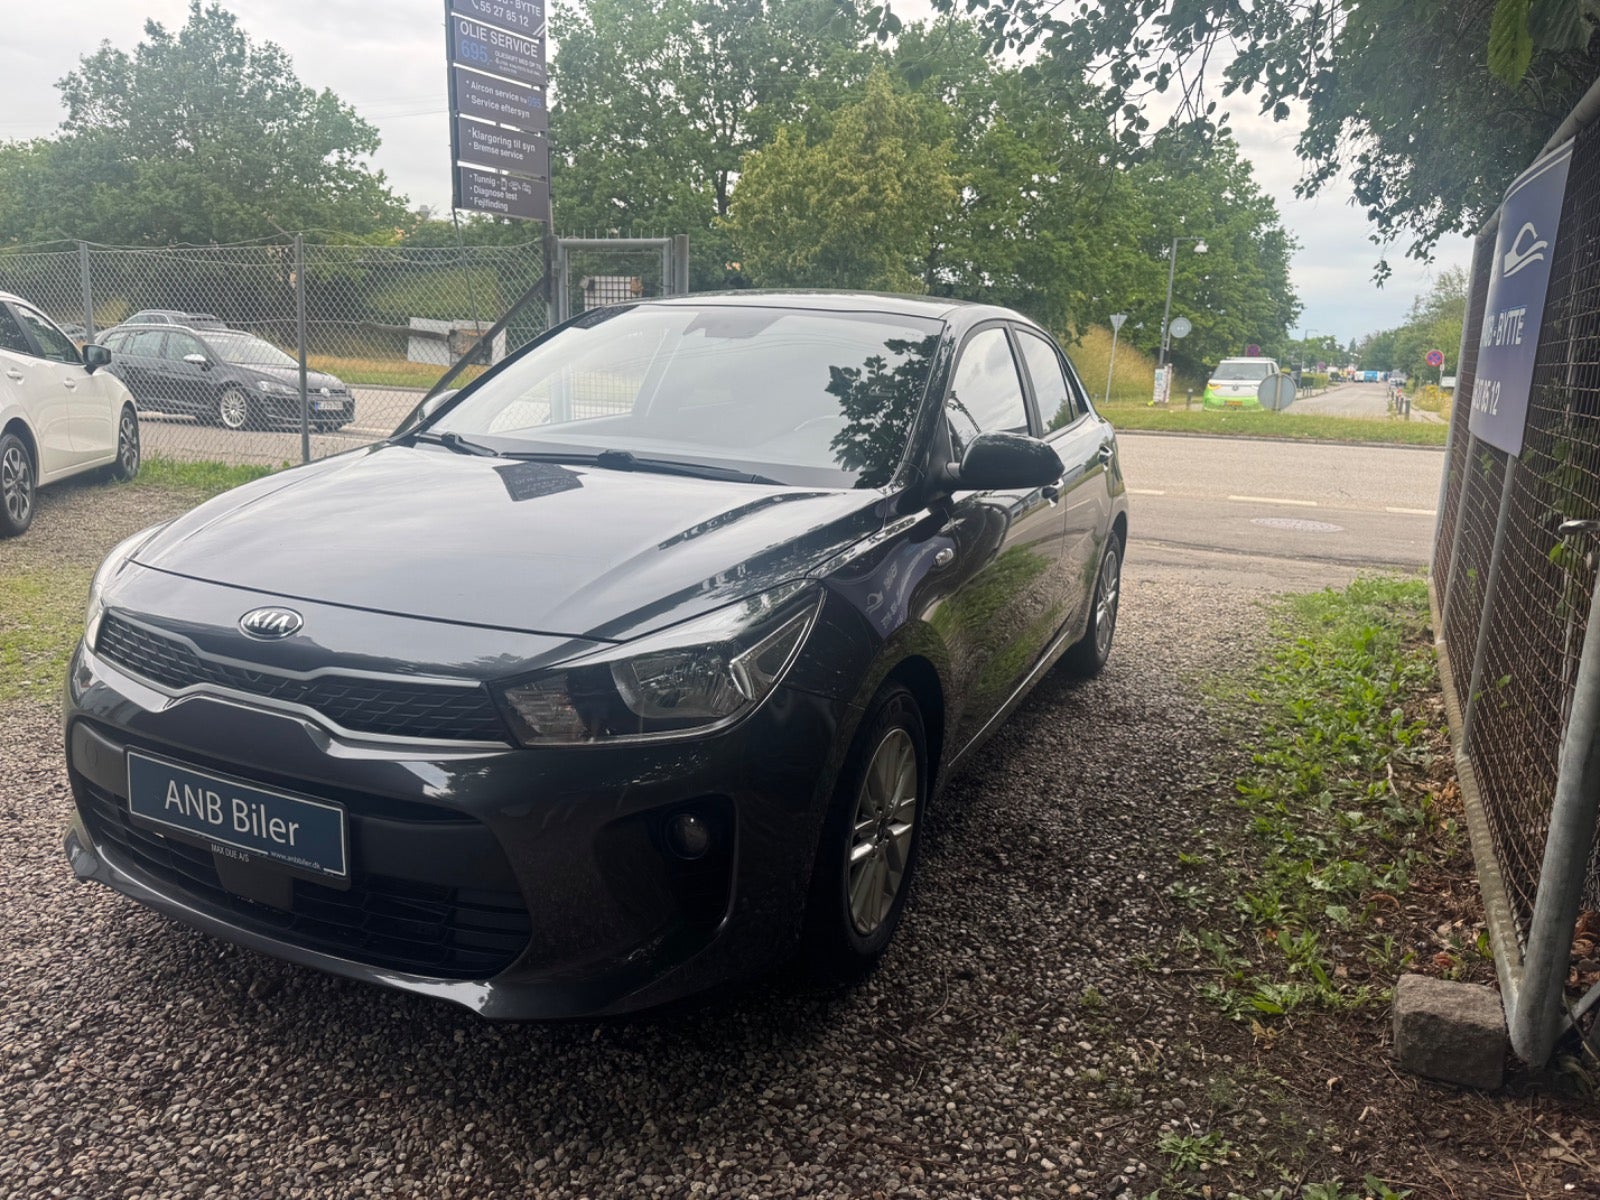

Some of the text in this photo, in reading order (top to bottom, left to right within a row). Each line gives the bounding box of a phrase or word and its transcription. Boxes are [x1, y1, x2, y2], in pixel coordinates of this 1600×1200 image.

[480, 1, 491, 13] 55
[493, 5, 504, 17] 27
[519, 15, 529, 27] 12
[460, 21, 538, 58] OLIE SERVICE
[471, 81, 494, 95] Aircon
[495, 89, 520, 102] service
[471, 94, 500, 111] Service
[473, 141, 524, 160] Bremse service
[522, 142, 536, 153] syn
[473, 185, 505, 198] Diagnose
[1496, 308, 1526, 346] BYTTE
[247, 610, 290, 633] KIA
[164, 779, 300, 847] ANB Biler
